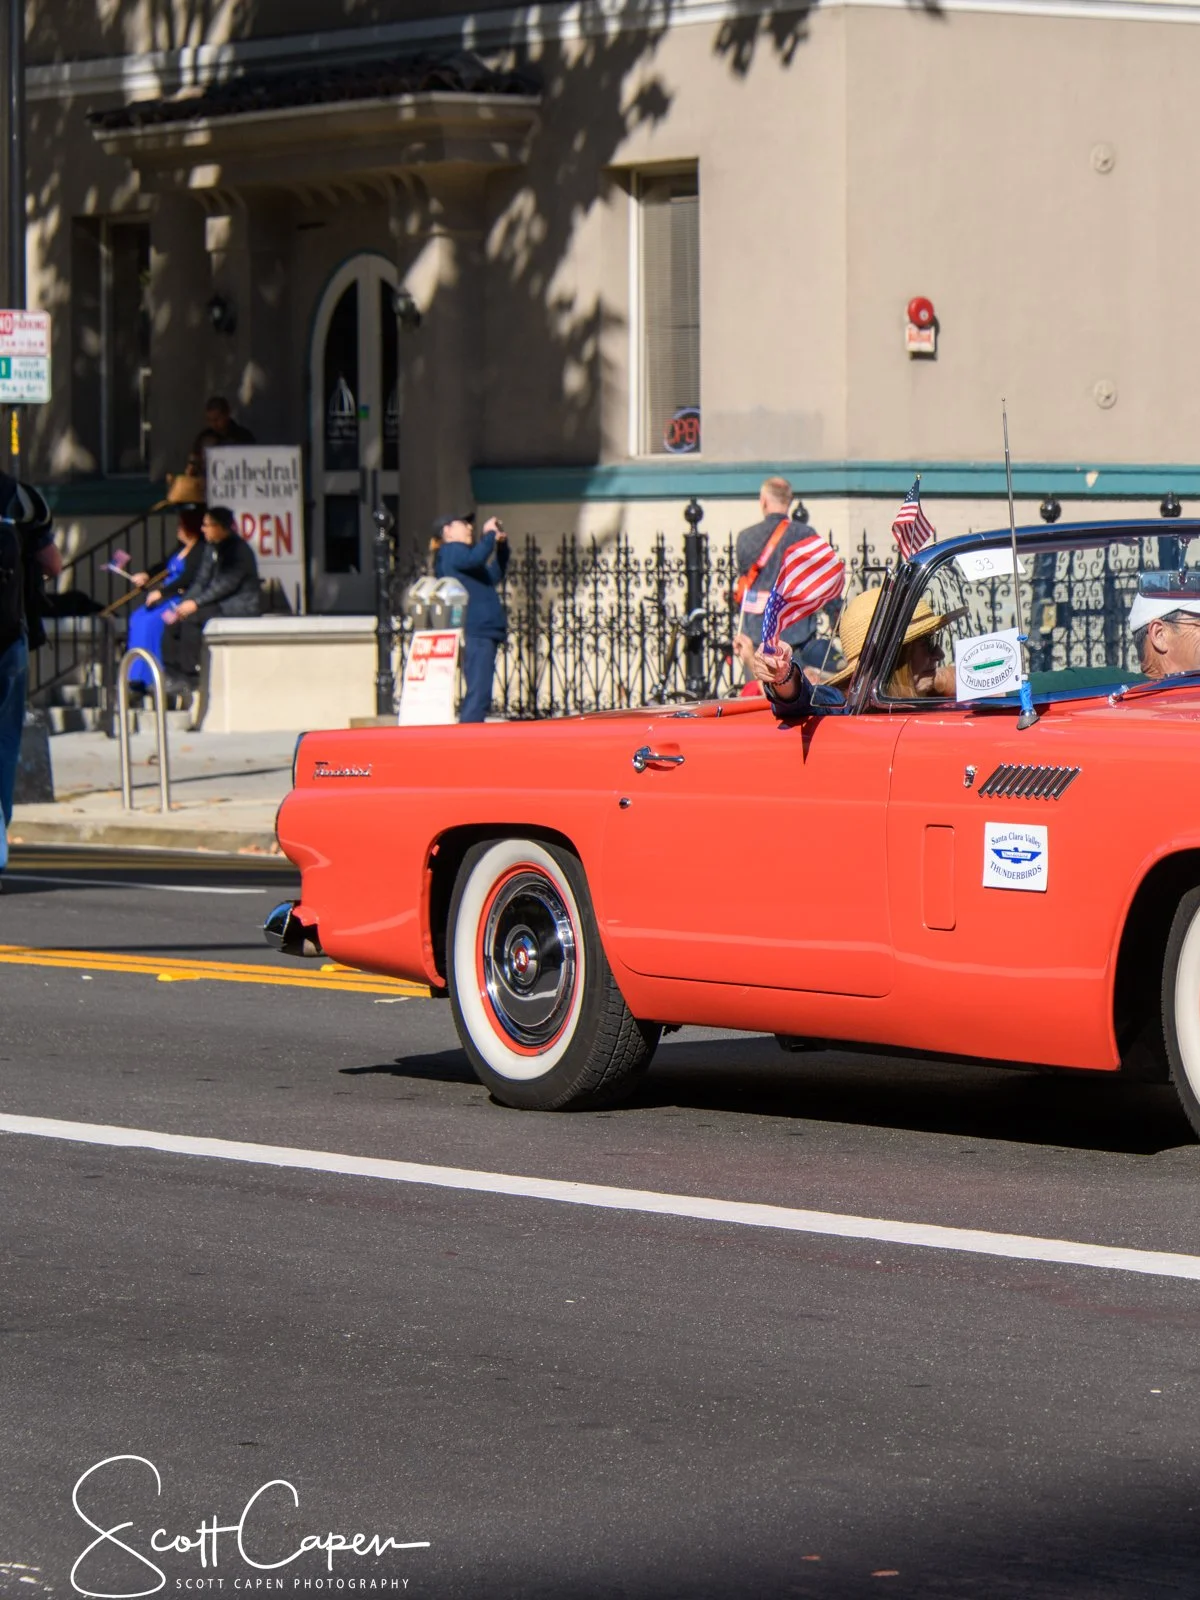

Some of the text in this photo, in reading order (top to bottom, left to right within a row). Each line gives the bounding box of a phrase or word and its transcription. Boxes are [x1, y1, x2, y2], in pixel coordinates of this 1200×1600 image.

[211, 457, 299, 481] Cathedral
[211, 482, 300, 498] GIFT SHOP
[231, 511, 294, 558] PEN
[974, 556, 995, 572] 33
[963, 641, 1012, 664] Santa Clara Valley
[965, 664, 1013, 688] THUNDERBIRDS
[991, 831, 1041, 849] Santa Clara Valley
[990, 860, 1042, 880] THUNDERBIRDS
